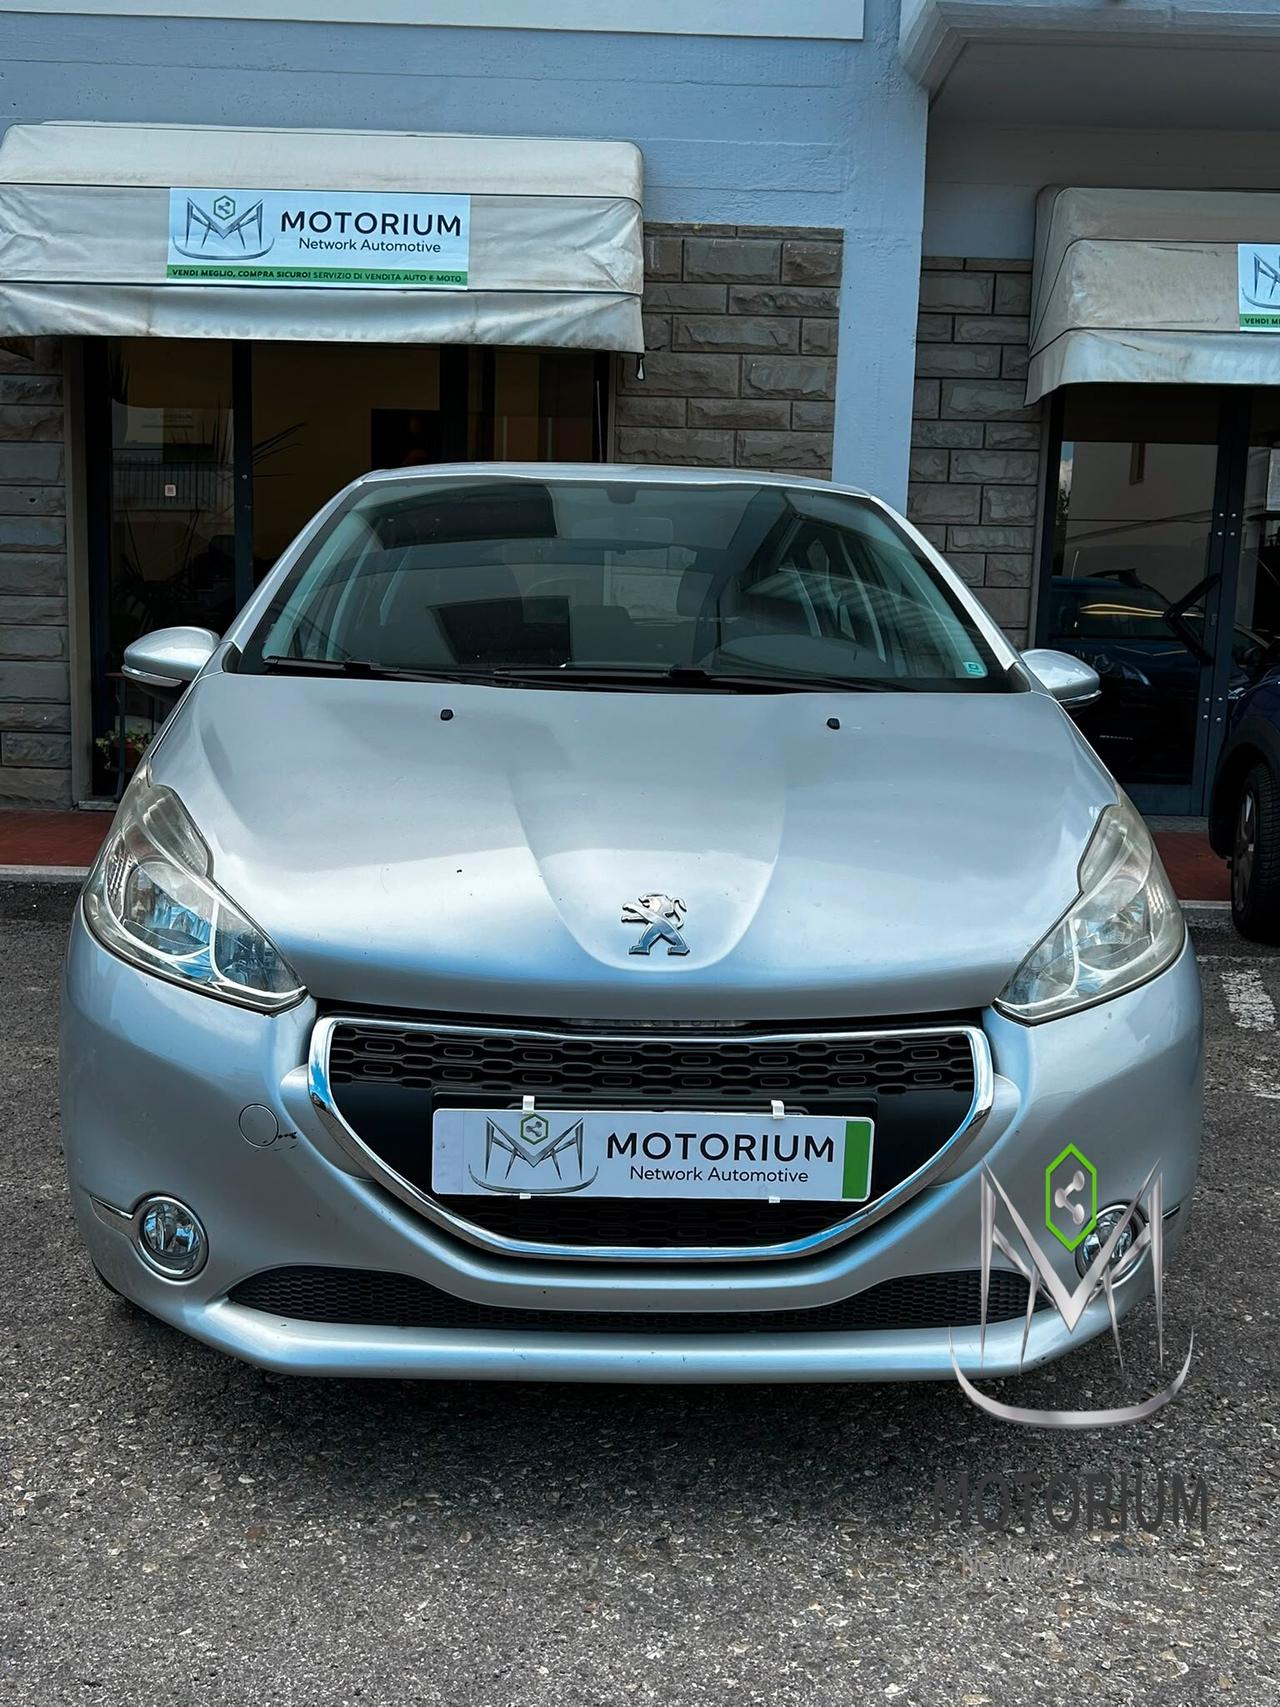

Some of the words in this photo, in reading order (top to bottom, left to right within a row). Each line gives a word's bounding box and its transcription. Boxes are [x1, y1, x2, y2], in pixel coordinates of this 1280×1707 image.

[281, 211, 461, 236] MOTORIUM
[299, 237, 357, 250] Network
[360, 238, 441, 253] Automotive
[201, 270, 235, 278] MEGLIO,
[237, 270, 274, 278] COMPRA
[313, 271, 351, 279] SERVIZIO
[365, 273, 400, 281] VENDITA
[436, 275, 462, 283] MOTO
[607, 1132, 834, 1162] MOTORIUM
[630, 1165, 703, 1181] Network
[707, 1167, 809, 1183] Automotive
